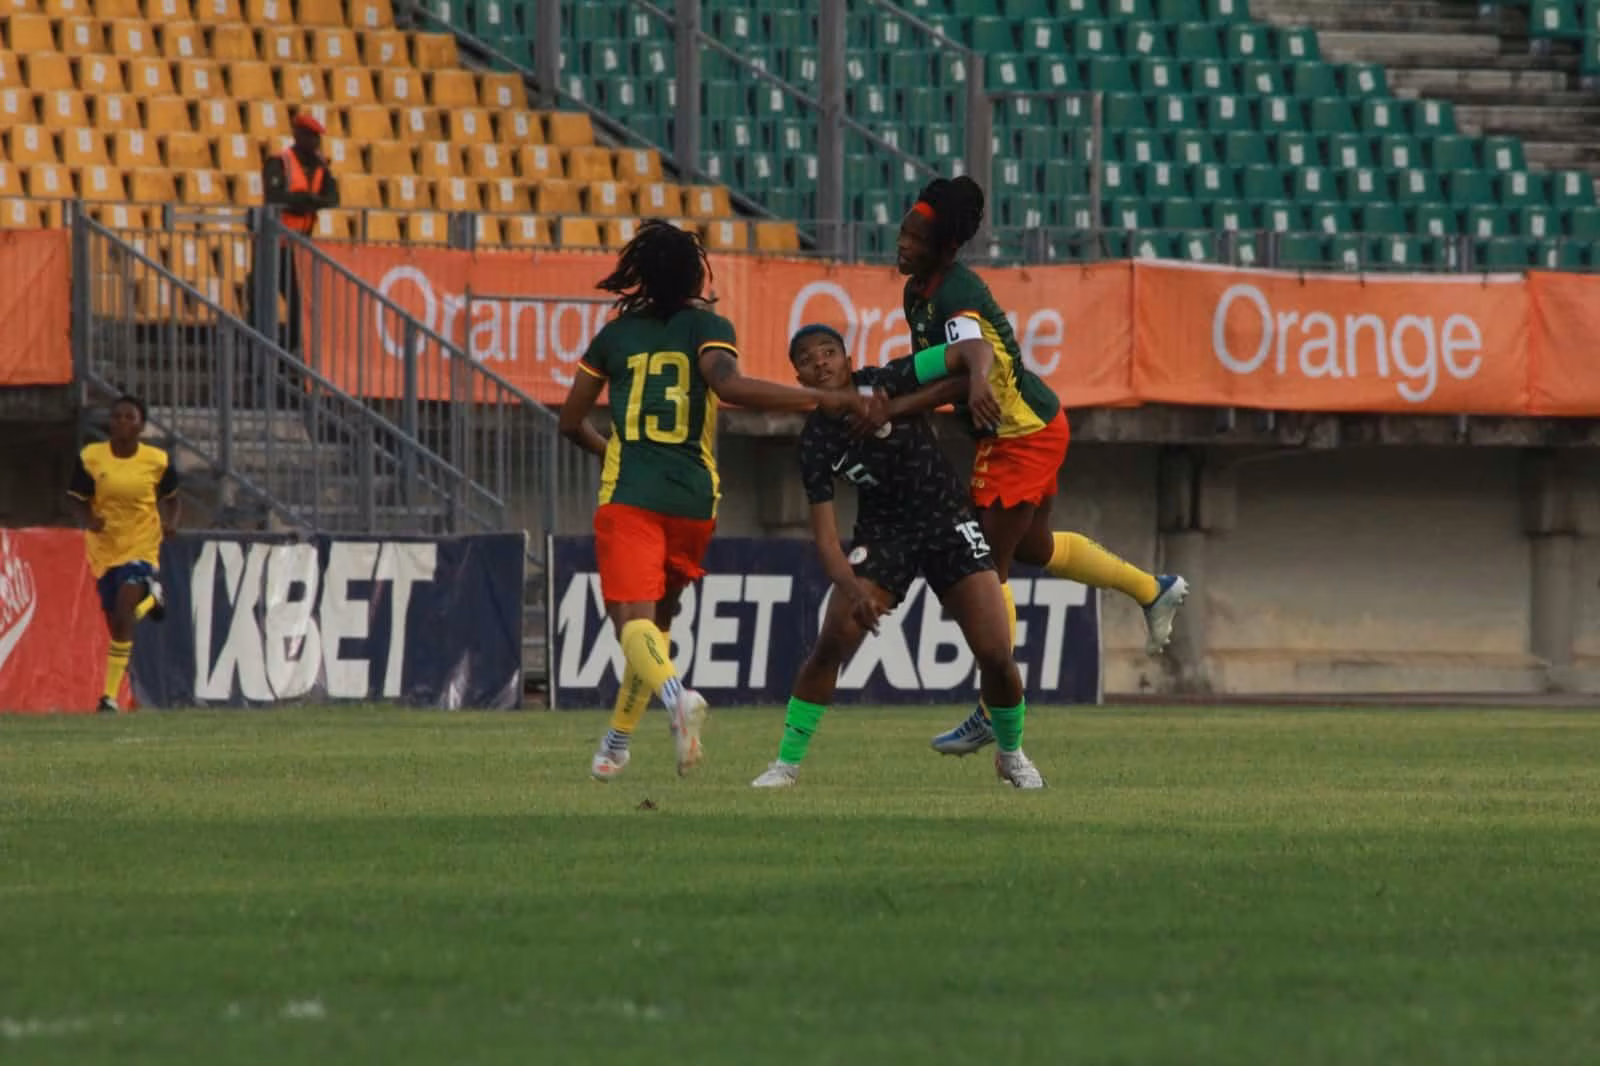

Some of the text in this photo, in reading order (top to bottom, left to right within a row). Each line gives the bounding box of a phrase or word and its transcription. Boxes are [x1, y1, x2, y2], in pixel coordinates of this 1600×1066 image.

[376, 265, 612, 387] Orang
[947, 320, 960, 341] C
[1212, 284, 1482, 401] Orange
[625, 351, 692, 445] 13
[955, 520, 991, 550] 15
[190, 541, 438, 700] 1XBET
